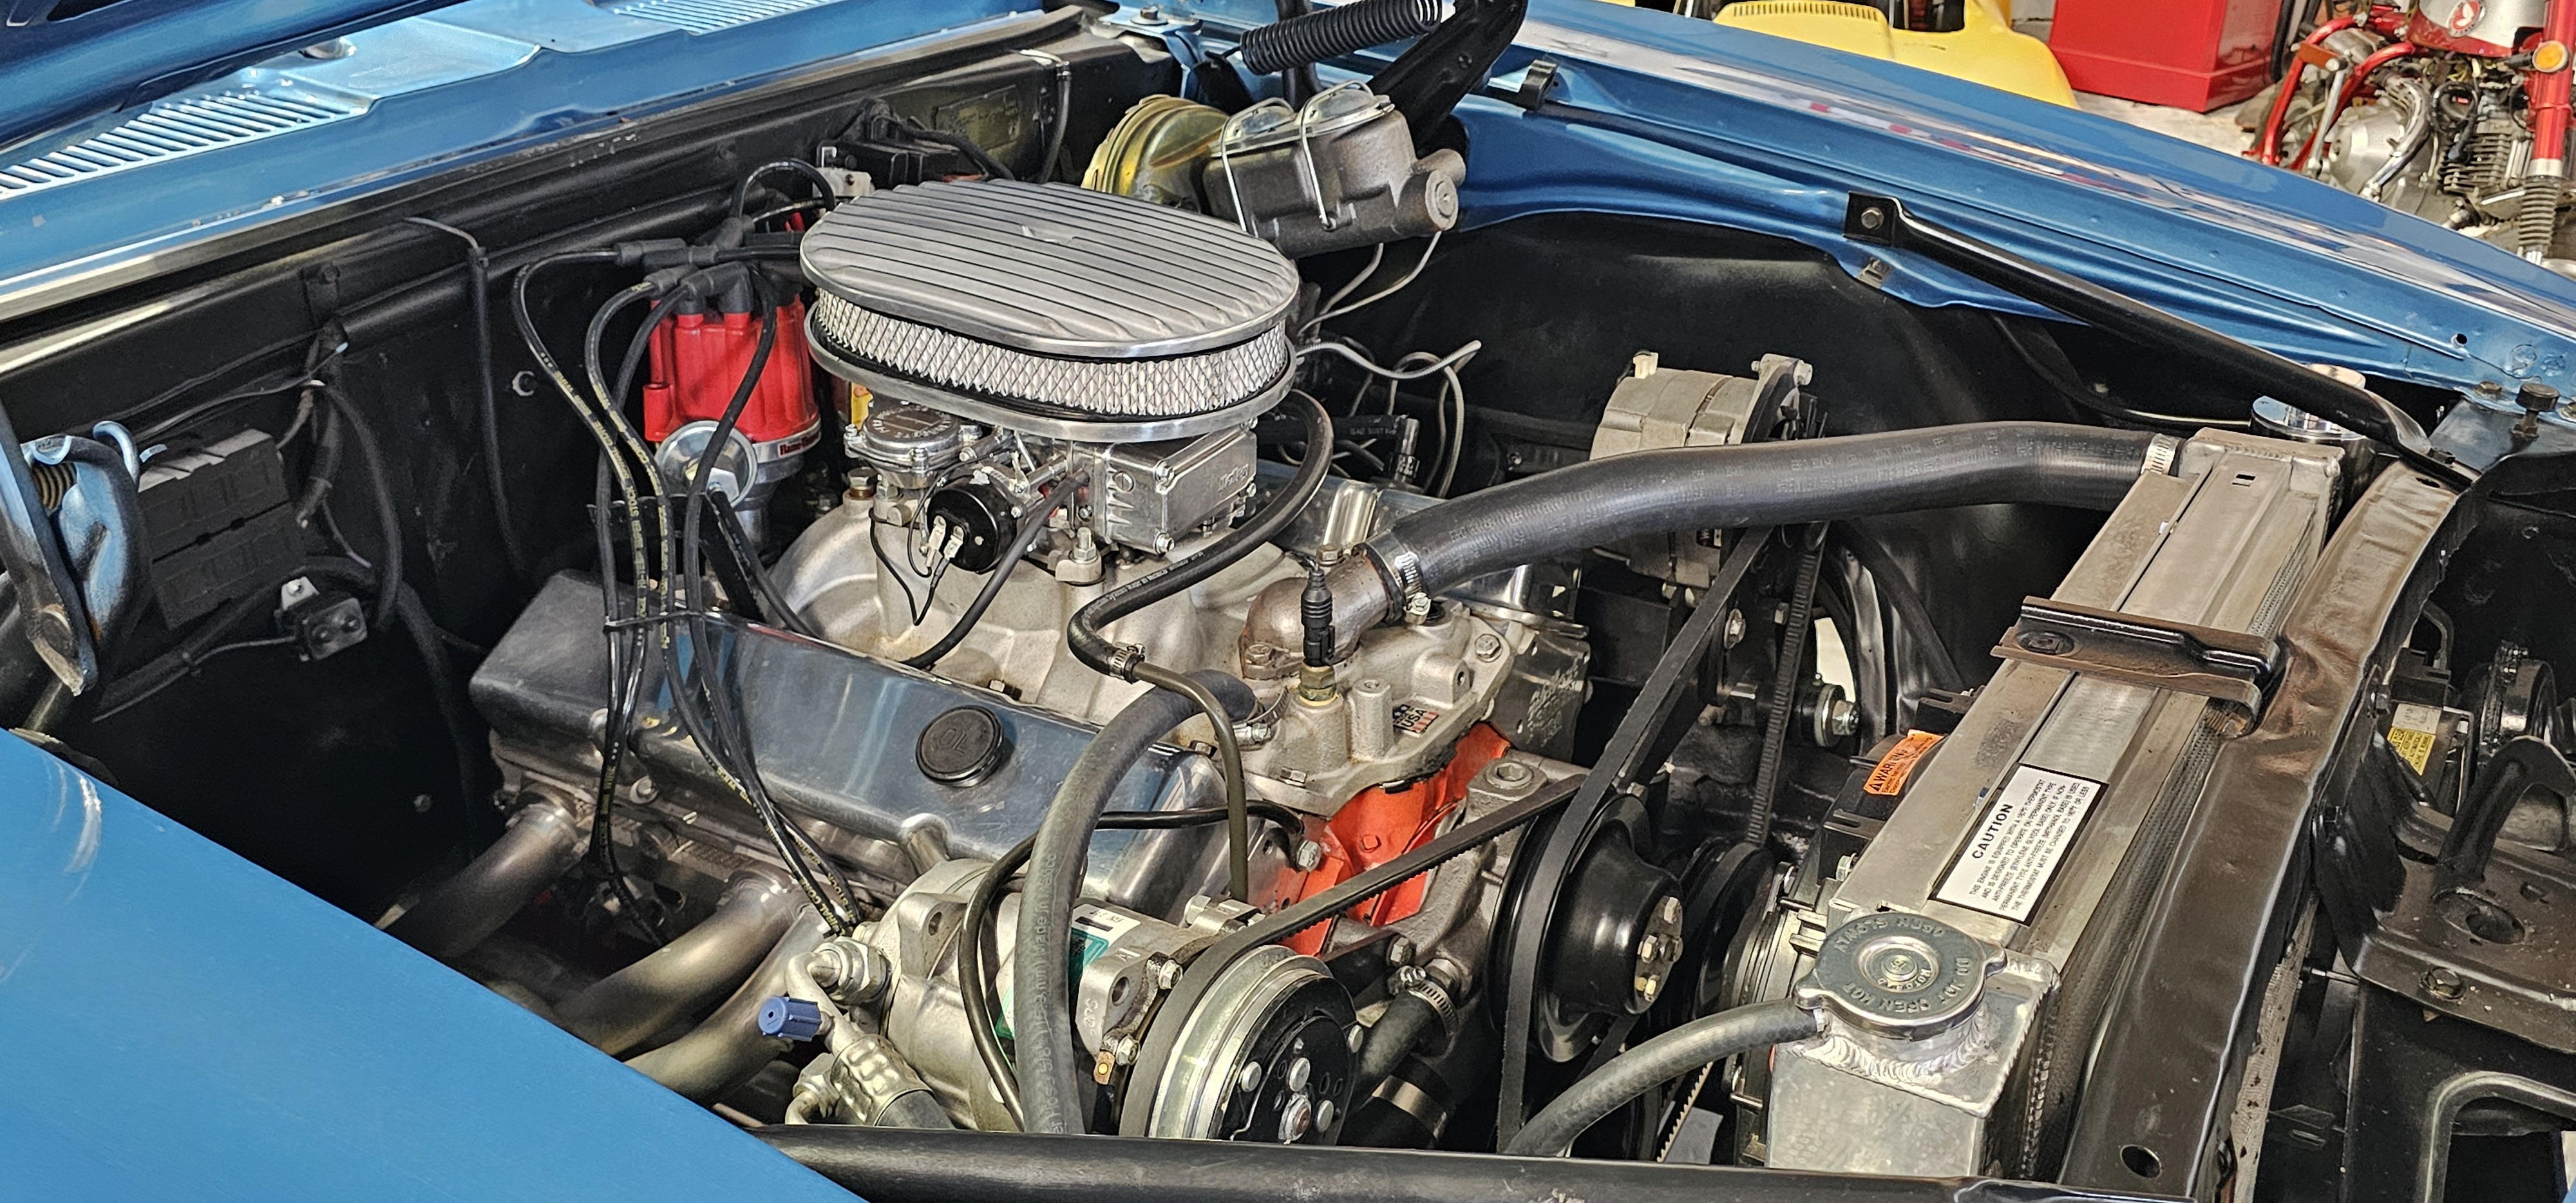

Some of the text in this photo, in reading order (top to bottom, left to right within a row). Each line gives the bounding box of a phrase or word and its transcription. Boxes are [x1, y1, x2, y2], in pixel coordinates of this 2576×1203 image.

[627, 486, 639, 517] STOCK
[1401, 710, 1428, 728] USA
[936, 728, 966, 755] OIL
[1972, 804, 2013, 858] CAUTION
[827, 875, 848, 905] STOCK
[1037, 851, 1058, 898] Mexico
[799, 877, 820, 904] CORE
[1032, 915, 1049, 955] Made
[1833, 916, 1946, 954] OPEN SLOWLY
[1842, 958, 1970, 1014] DO NOT OPEN HOT
[1877, 967, 1931, 991] MOTORAD
